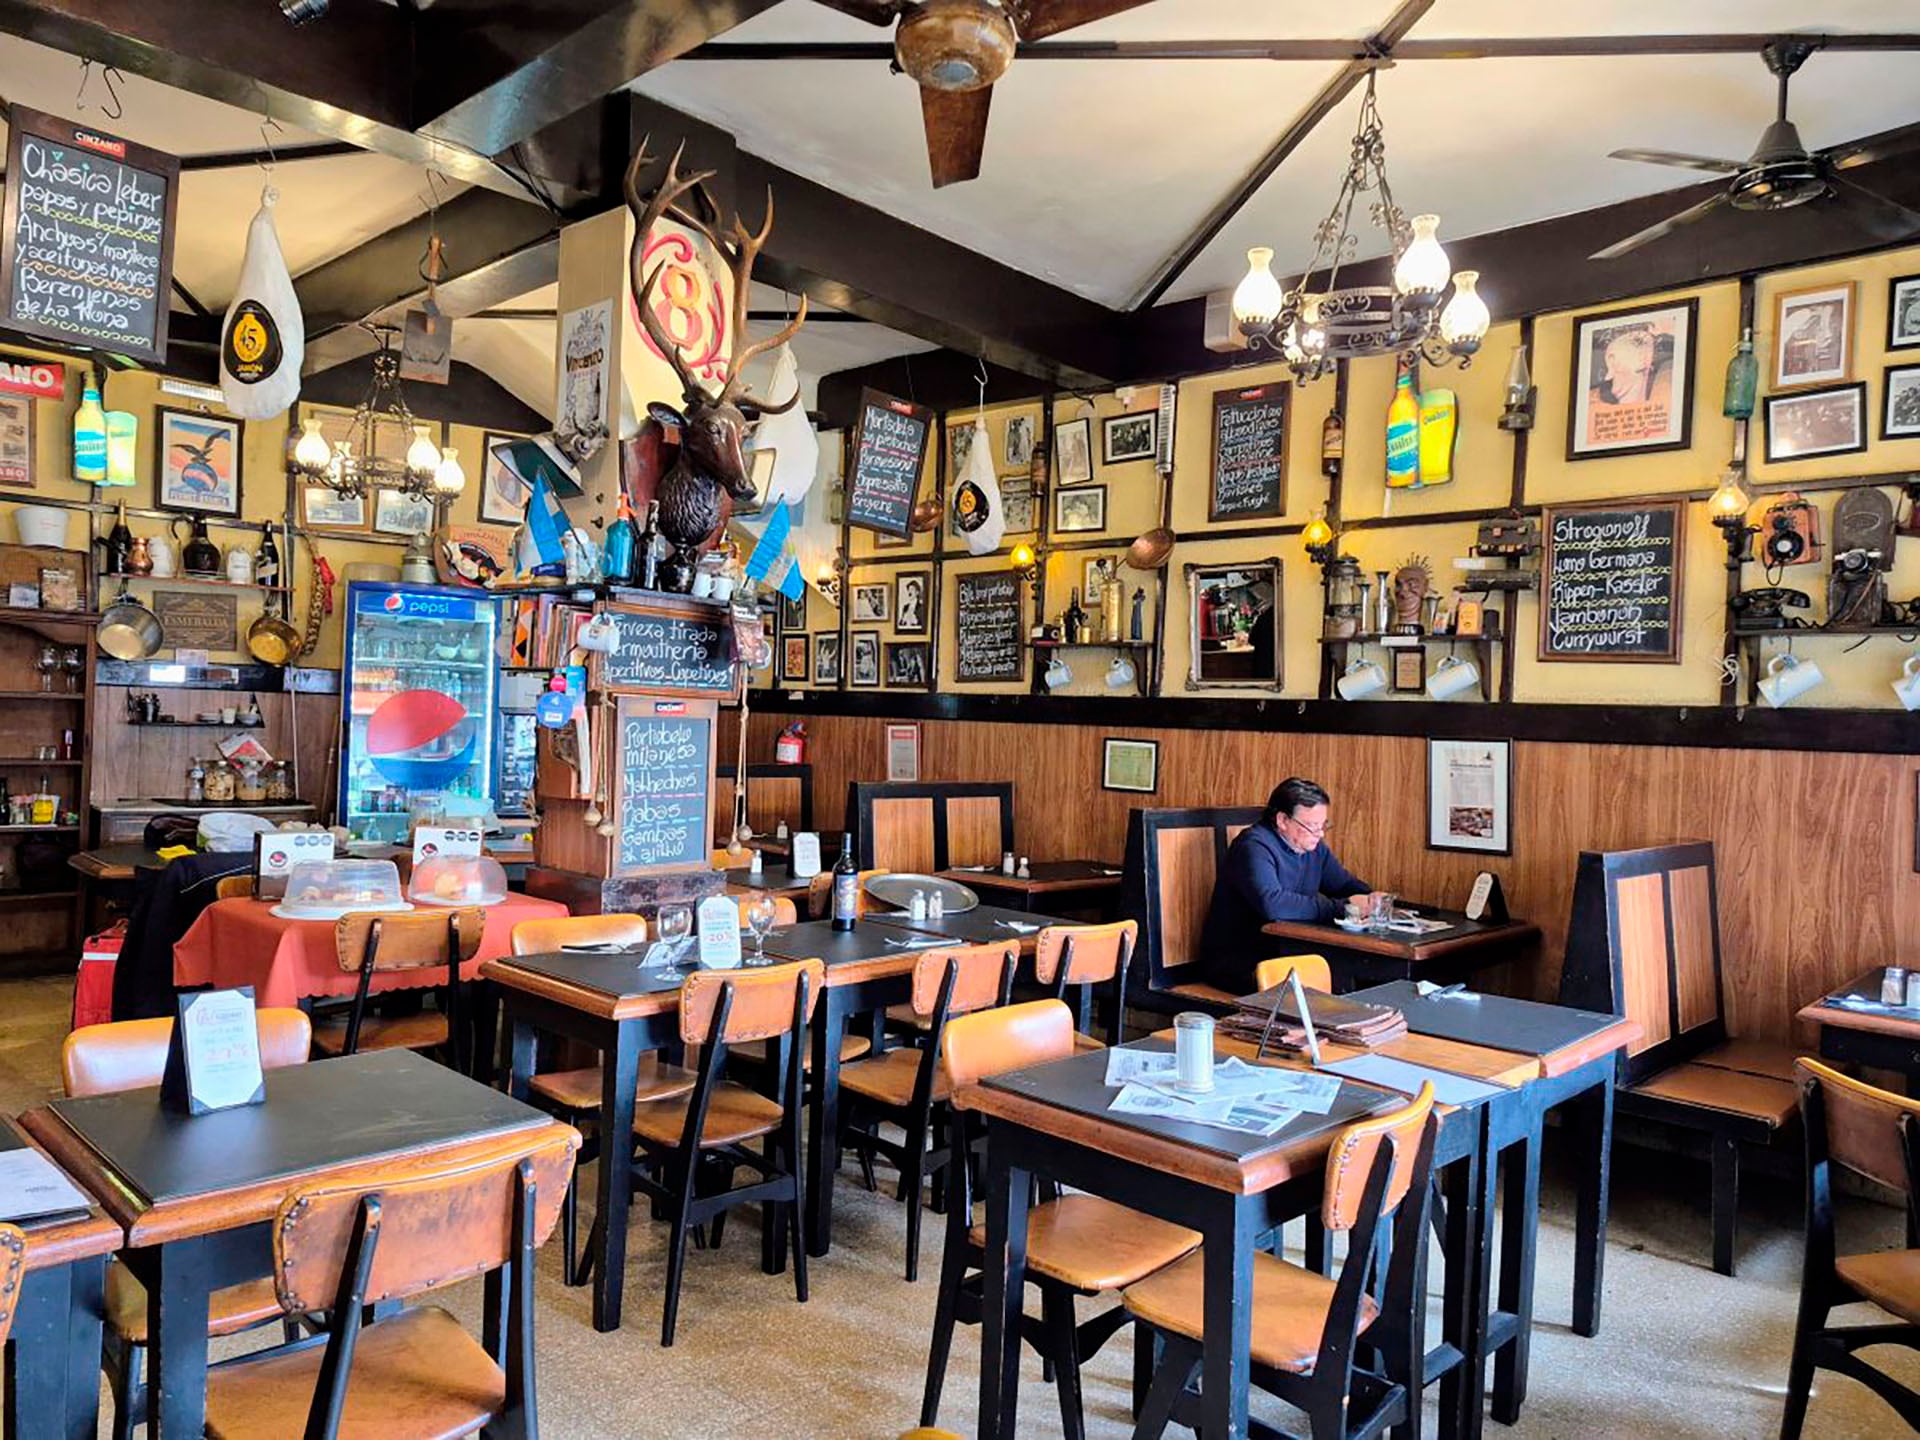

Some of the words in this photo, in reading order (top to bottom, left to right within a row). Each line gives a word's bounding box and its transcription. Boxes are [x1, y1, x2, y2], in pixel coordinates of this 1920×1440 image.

[20, 181, 78, 216] papas
[80, 202, 89, 216] y
[16, 242, 26, 263] y
[15, 293, 41, 314] de
[409, 602, 449, 614] pepsi
[668, 618, 718, 642] tirada
[1552, 625, 1647, 651] Currywurst
[625, 744, 697, 768] milanesa
[622, 824, 688, 846] Gambas
